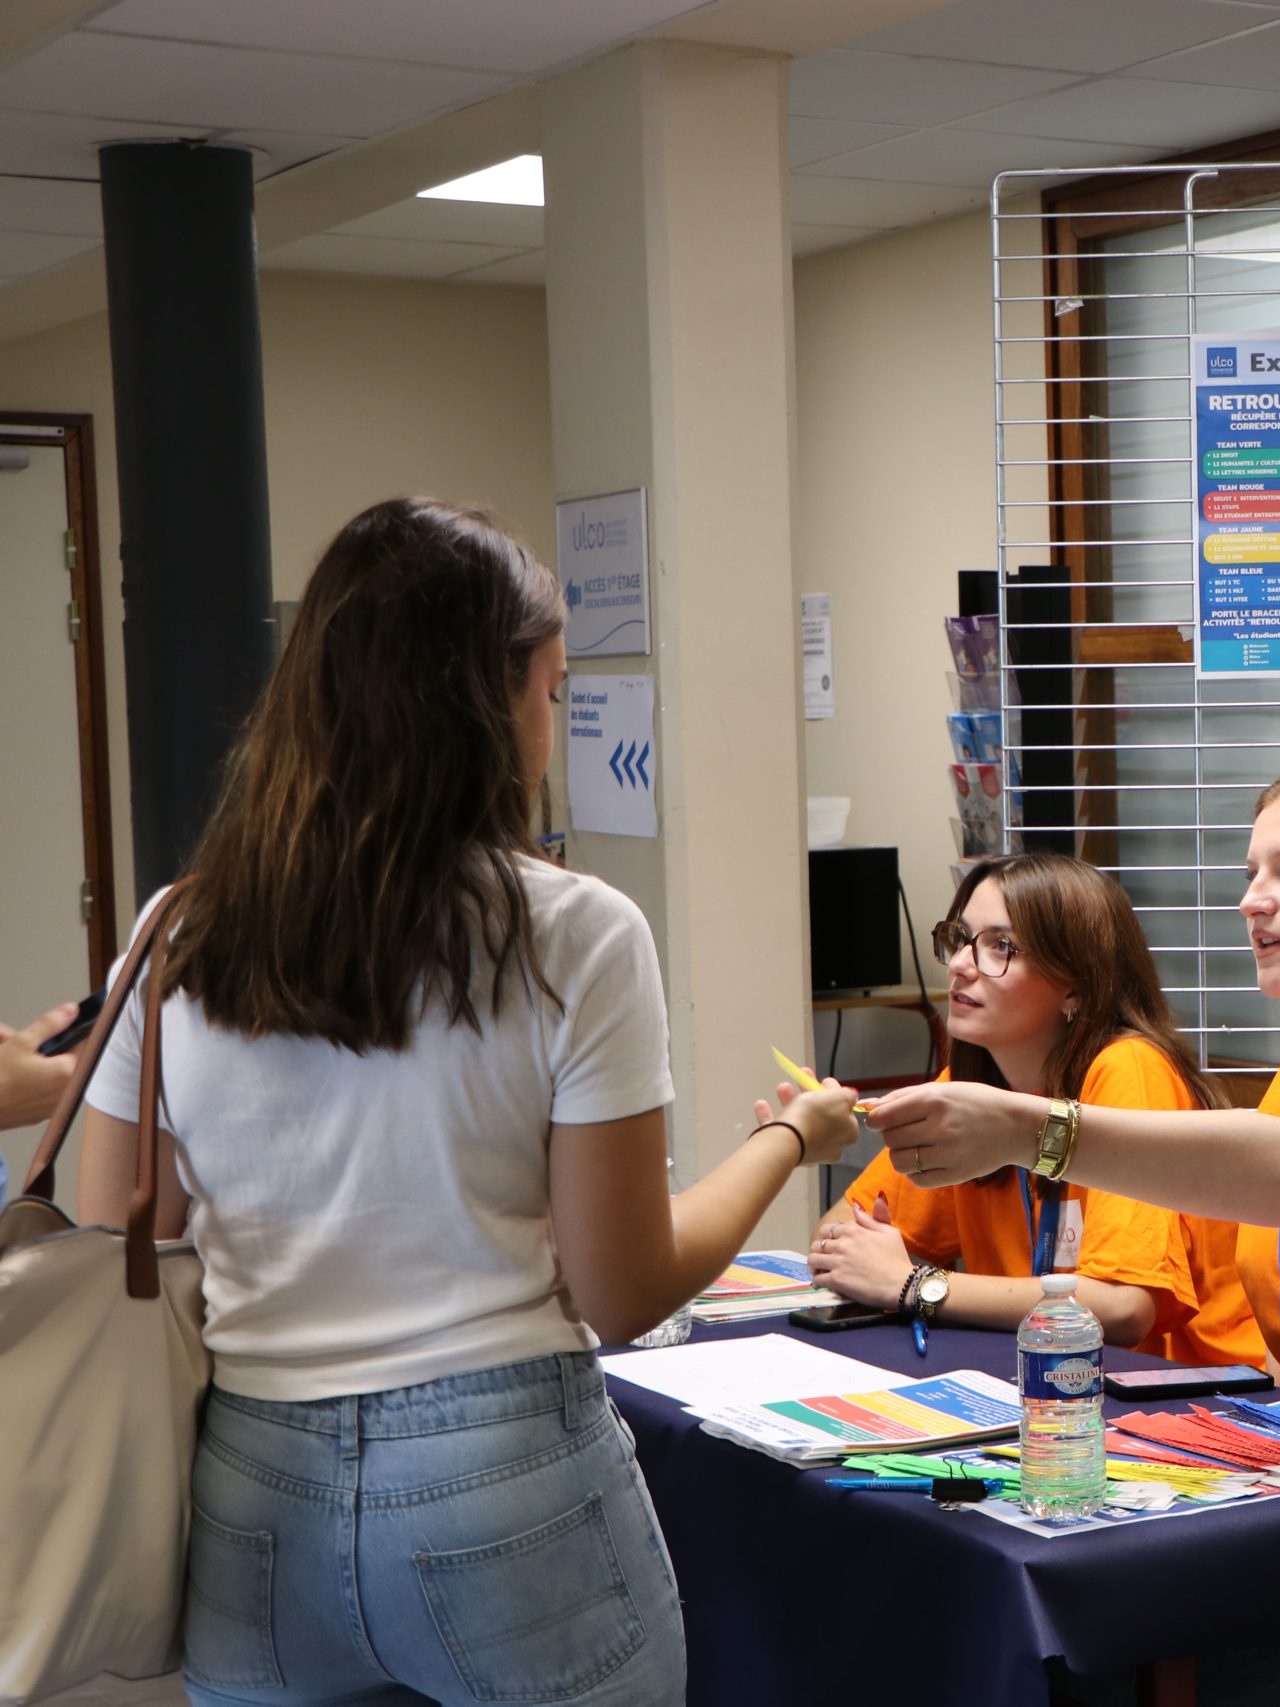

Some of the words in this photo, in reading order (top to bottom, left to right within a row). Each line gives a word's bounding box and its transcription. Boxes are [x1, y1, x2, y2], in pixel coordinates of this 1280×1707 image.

[1231, 411, 1277, 421] RÉCUPÈRE
[573, 511, 605, 551] ulco
[618, 572, 640, 591] ÉTAGE
[1212, 610, 1238, 618] PORTE
[1203, 617, 1245, 627] ACTIVITÉS
